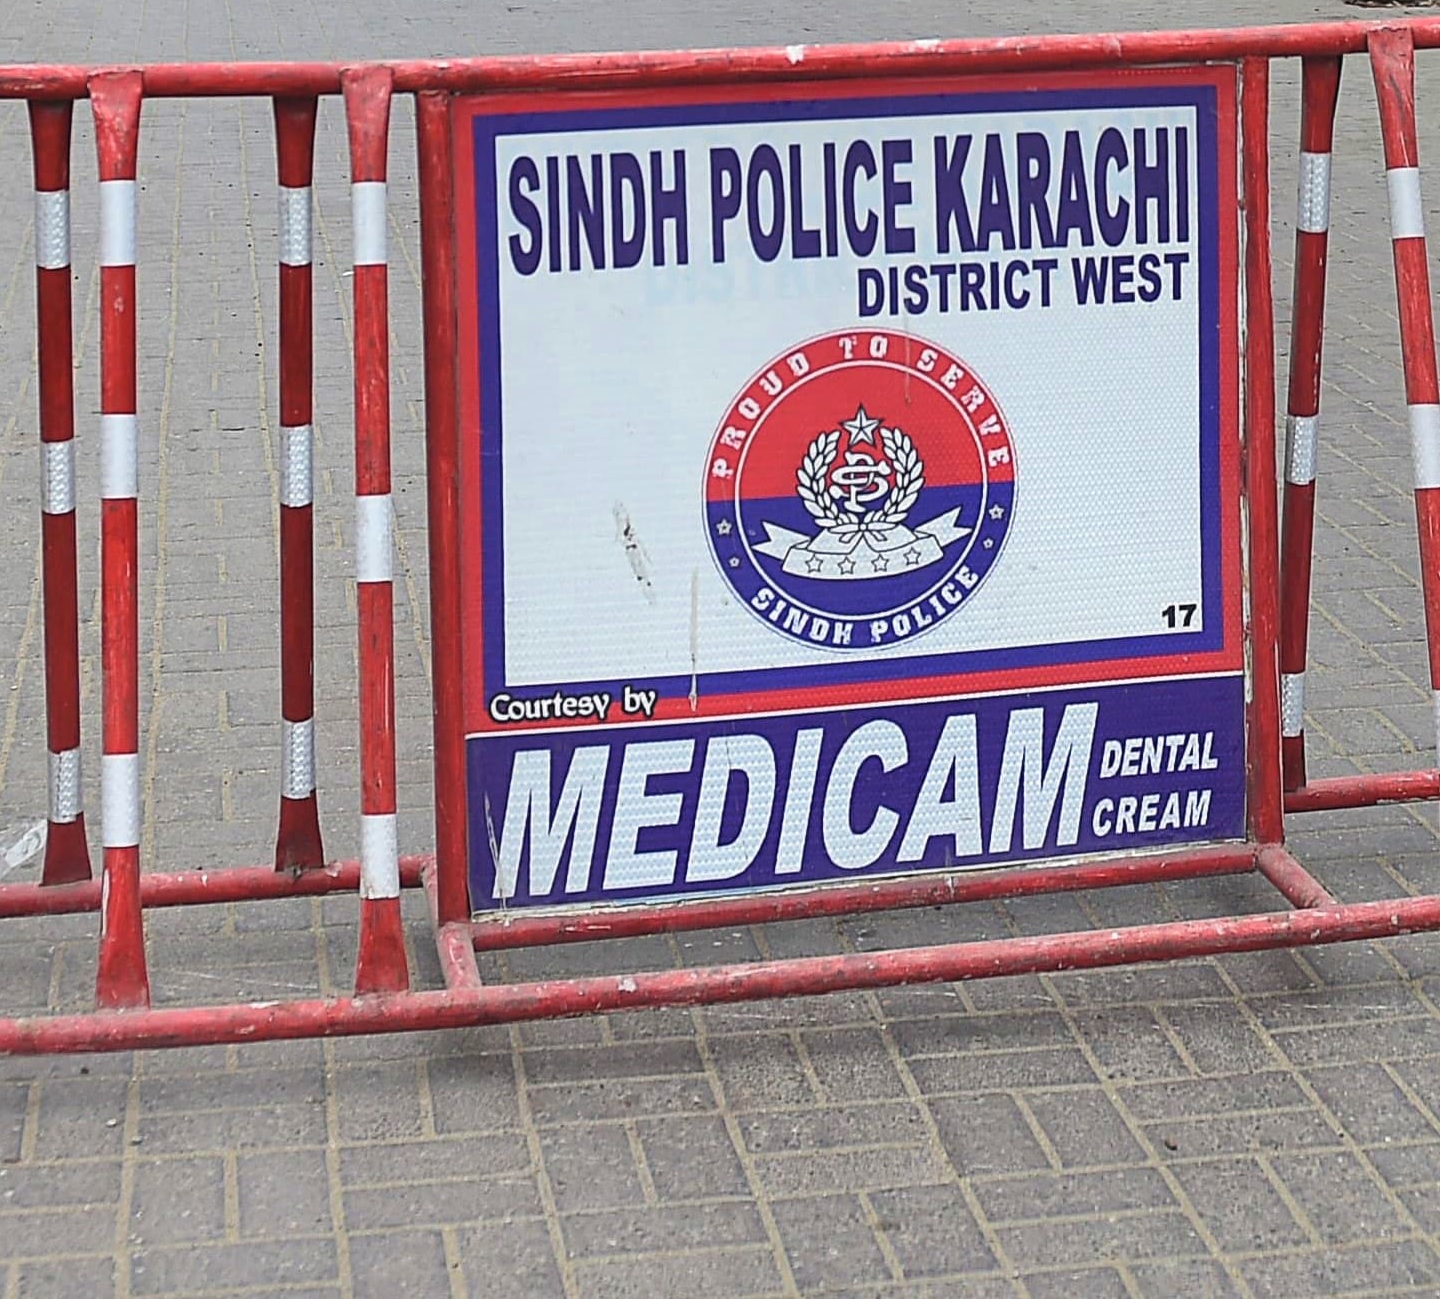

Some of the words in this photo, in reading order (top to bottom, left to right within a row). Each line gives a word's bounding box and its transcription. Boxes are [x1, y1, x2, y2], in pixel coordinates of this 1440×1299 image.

[507, 148, 690, 277] SINDH
[708, 138, 916, 265] POLICE
[932, 125, 1191, 255] KARACHI
[858, 258, 1059, 318] DISTRICT
[1071, 252, 1191, 307] WEST
[711, 351, 810, 480] PROUD
[838, 335, 889, 360] TO
[916, 348, 1011, 468] SERVE
[750, 586, 854, 645] SINDH
[870, 565, 979, 643] POLICE
[1161, 604, 1198, 630] 17
[489, 691, 611, 723] Courtesy
[622, 686, 657, 716] by
[1100, 731, 1219, 779] DENTAL
[490, 701, 1099, 900] MEDICAM
[1092, 789, 1212, 838] CREAM
